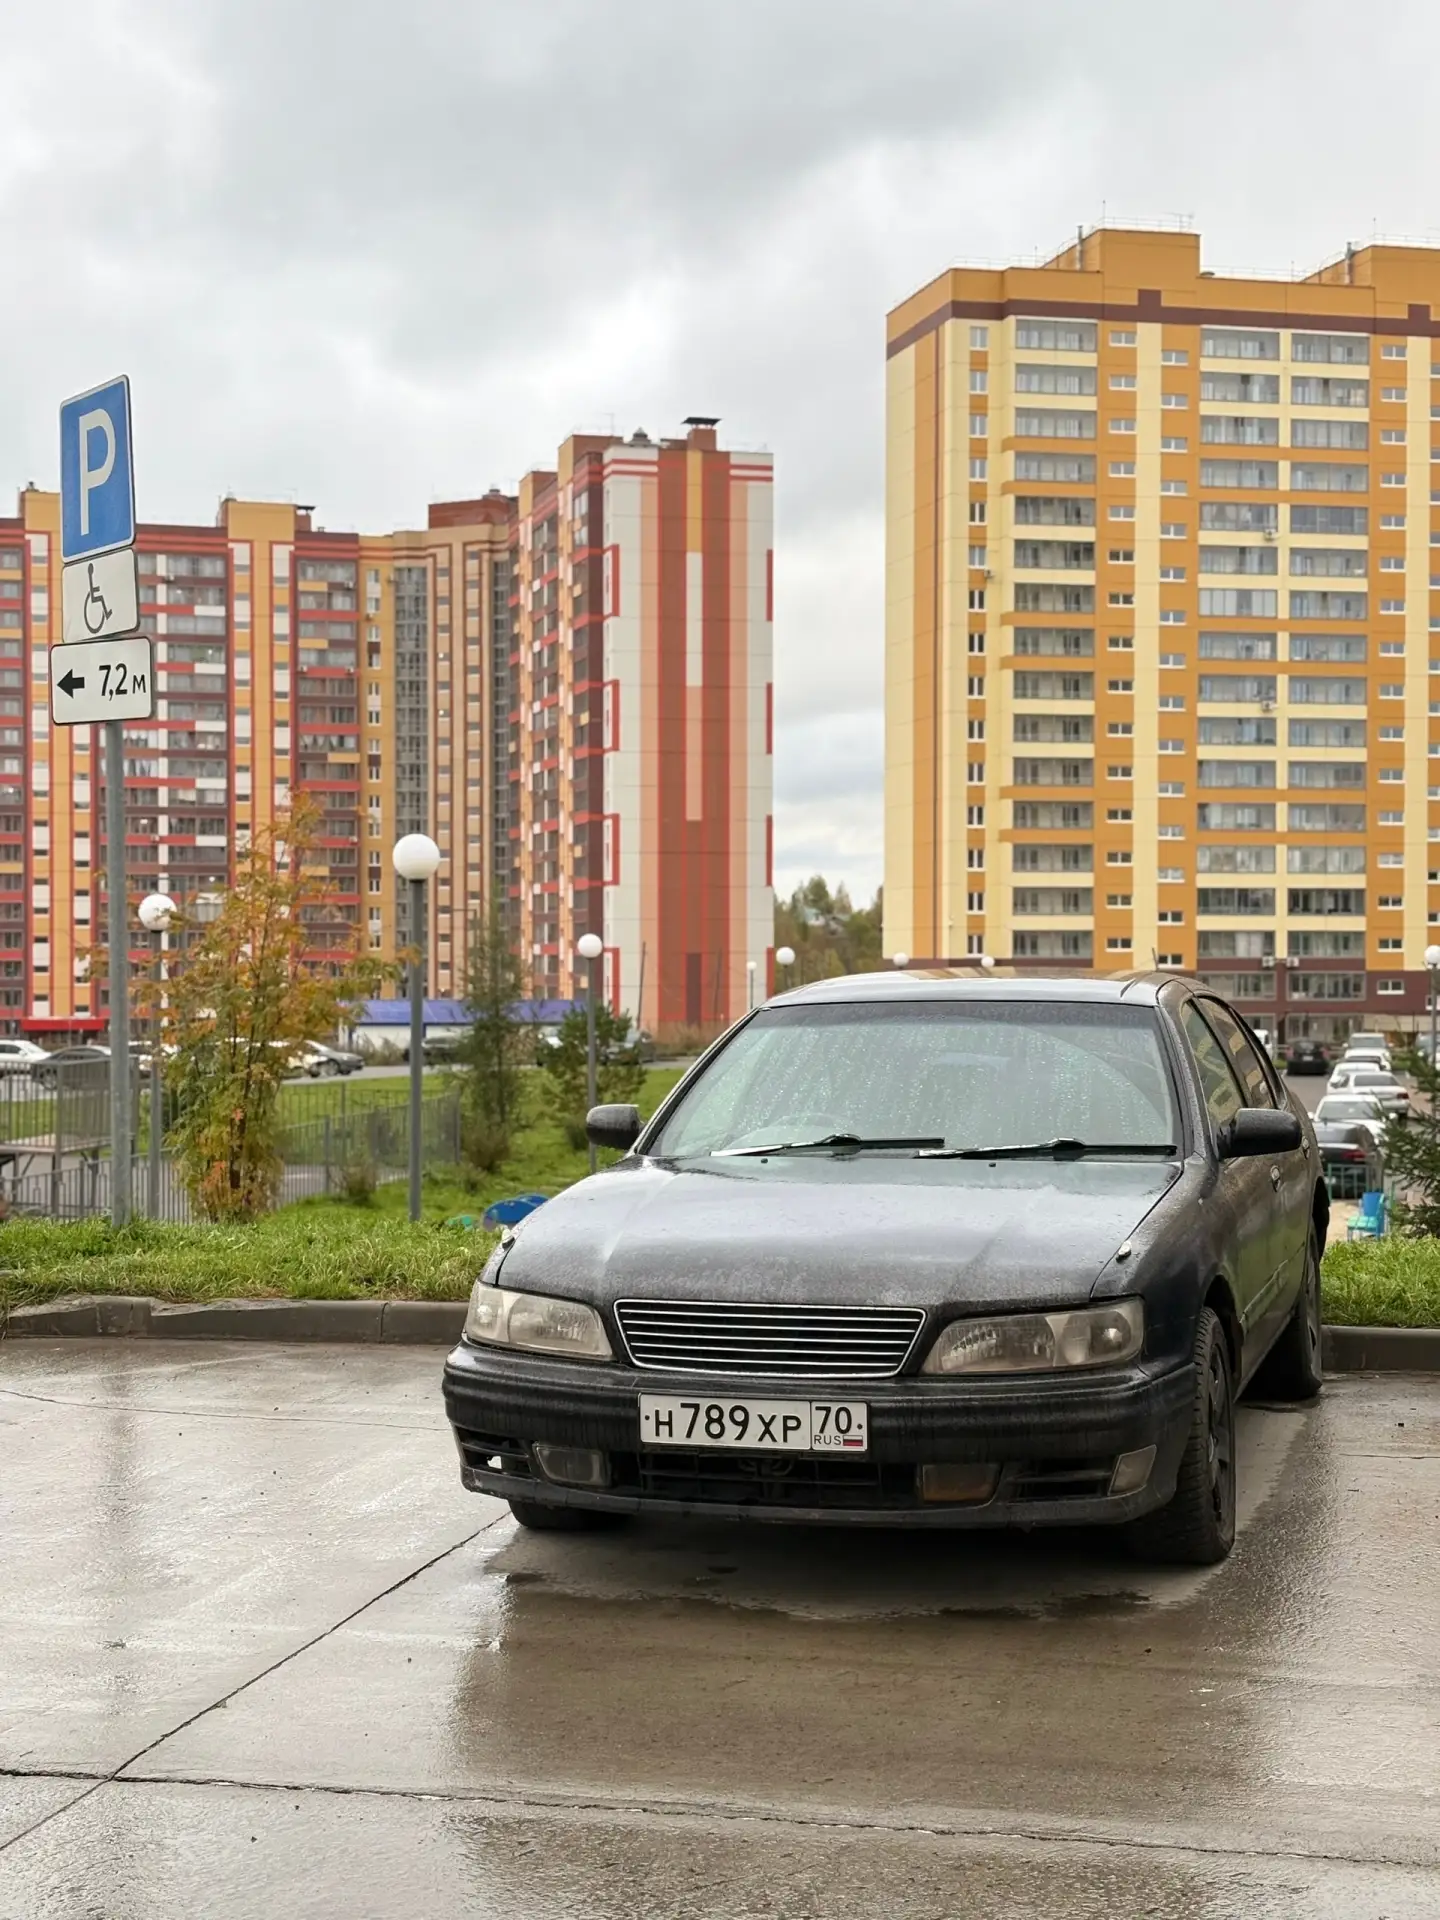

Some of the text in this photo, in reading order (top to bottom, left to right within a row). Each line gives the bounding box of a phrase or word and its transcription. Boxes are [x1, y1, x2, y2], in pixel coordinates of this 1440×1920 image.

[79, 408, 116, 536] P
[98, 662, 128, 702] 7,2
[814, 1406, 853, 1434] 70
[813, 1434, 842, 1446] RUS
